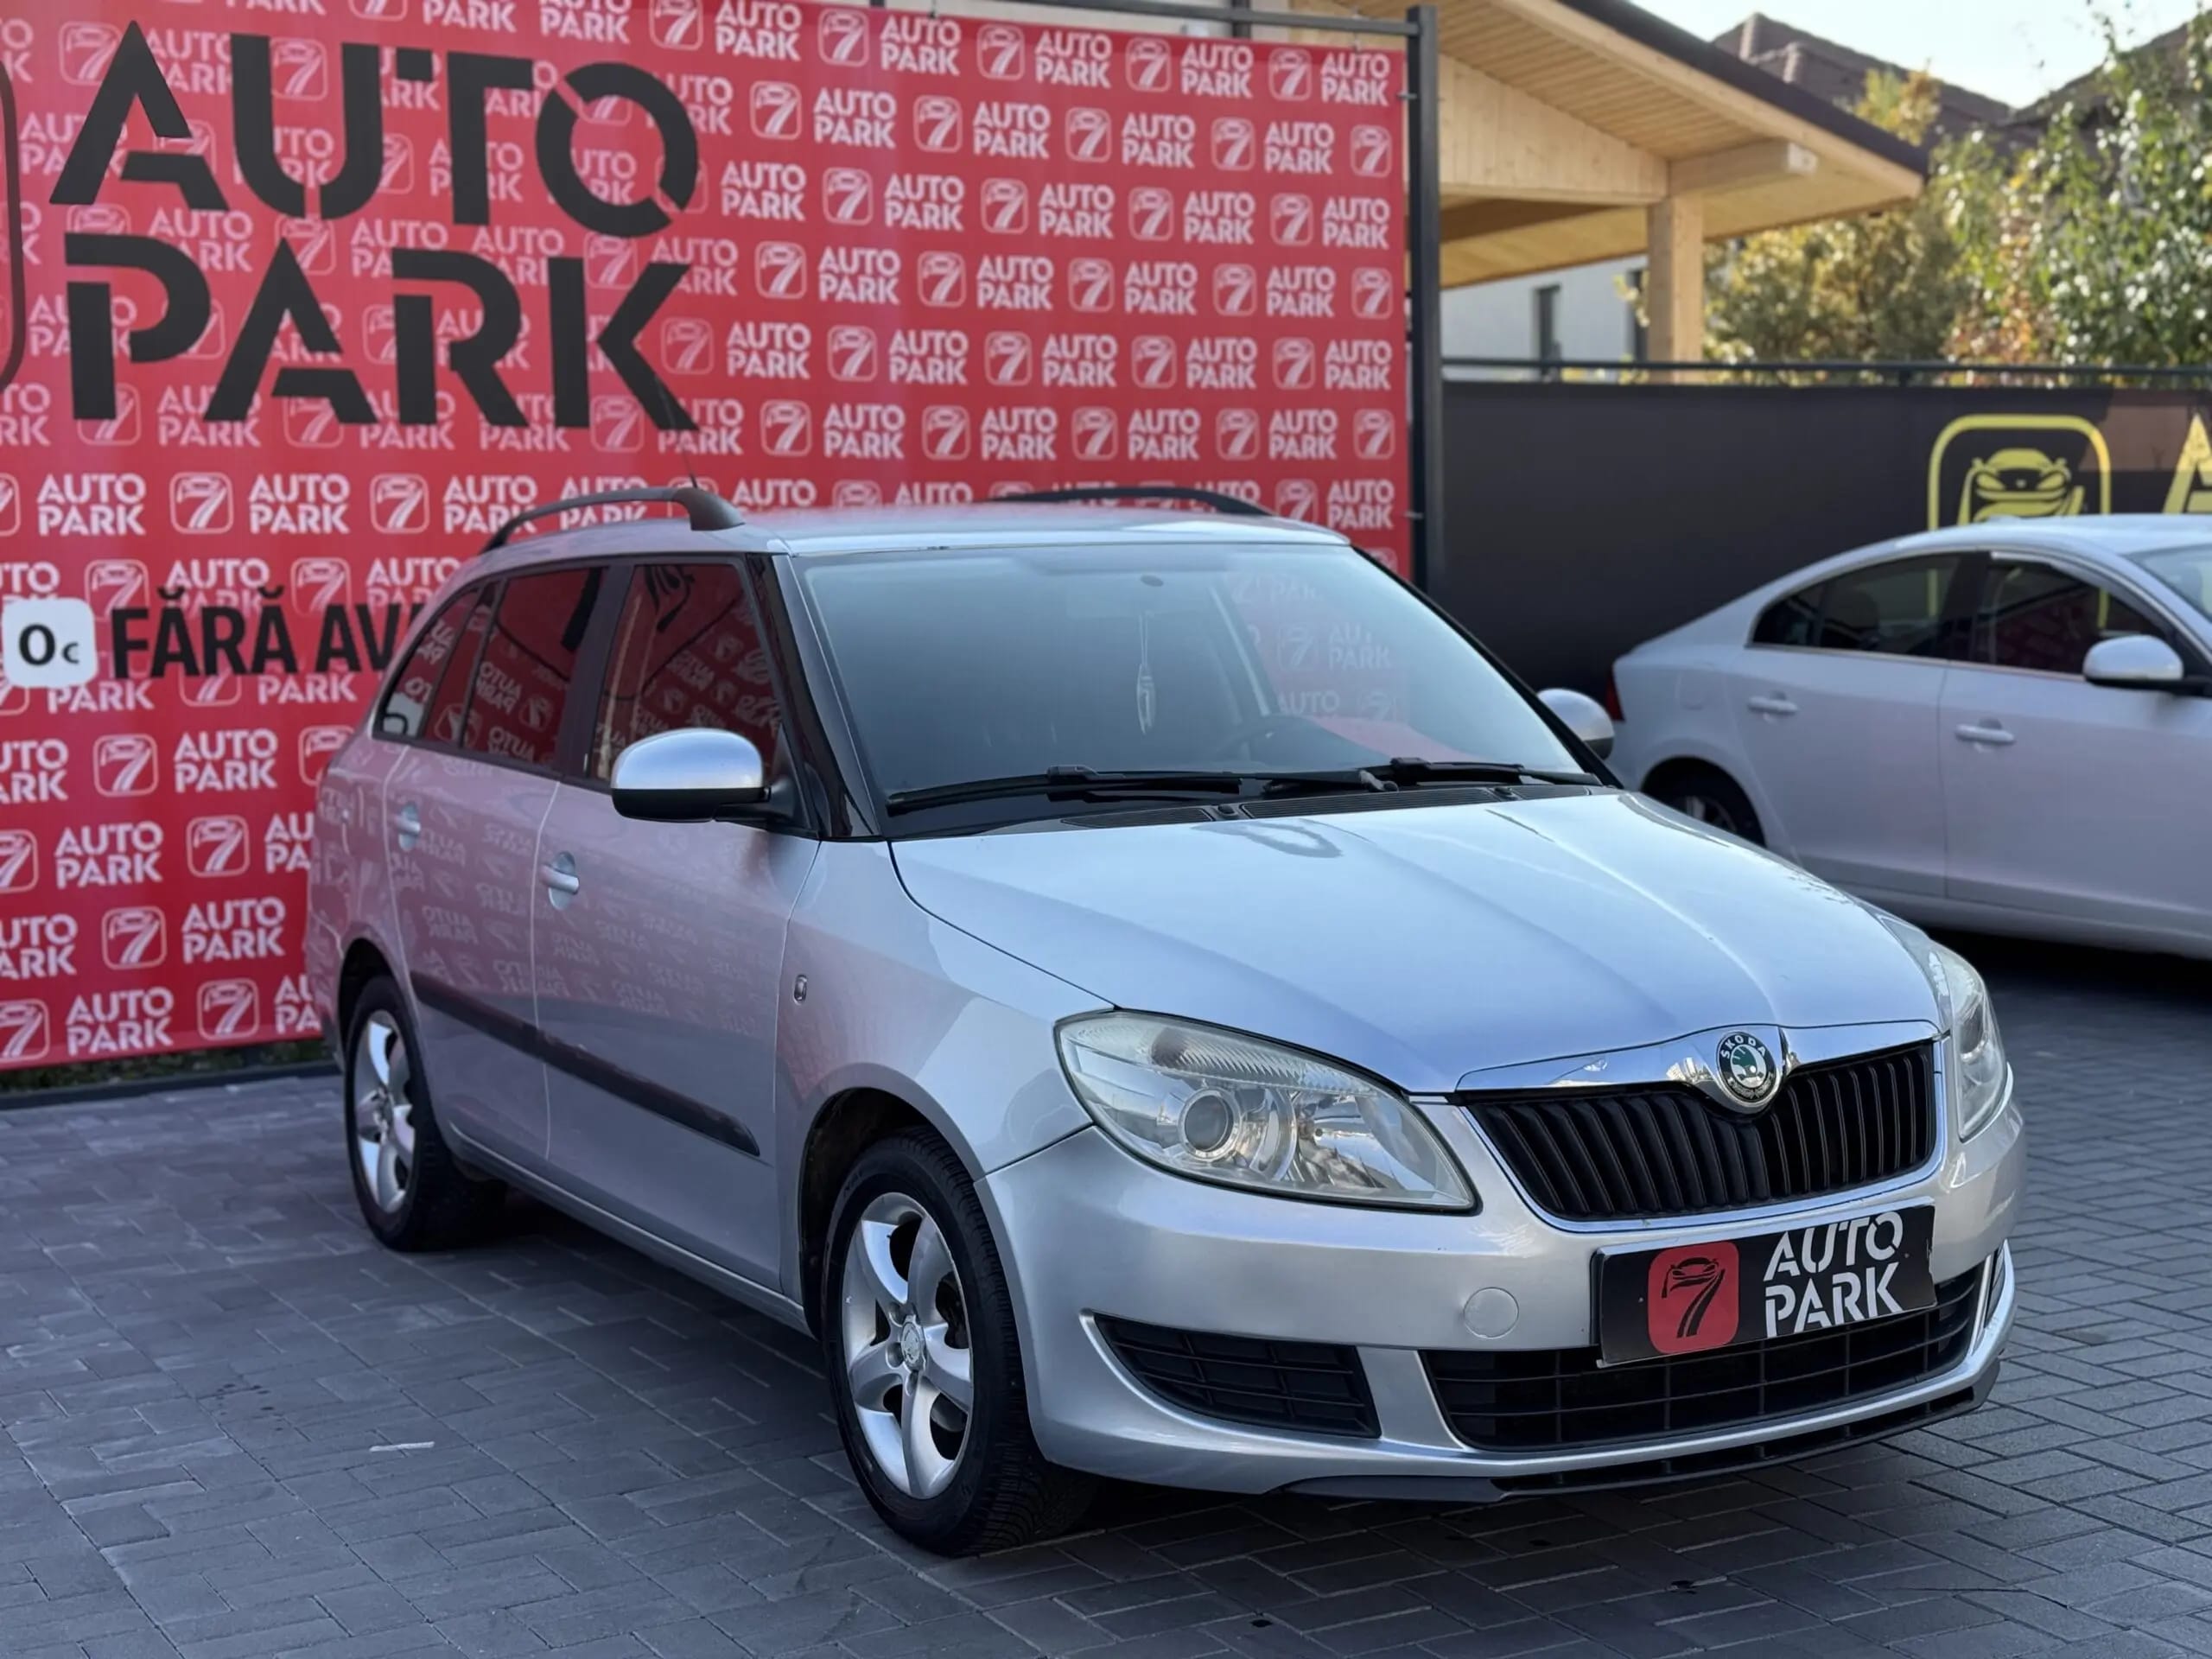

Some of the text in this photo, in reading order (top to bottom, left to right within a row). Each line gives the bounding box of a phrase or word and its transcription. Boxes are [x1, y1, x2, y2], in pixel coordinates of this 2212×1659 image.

[423, 1, 517, 33] PARK
[540, 12, 630, 43] PARK
[715, 0, 801, 31] AUTO
[716, 24, 799, 60] PARK
[880, 16, 962, 47] AUTO
[1035, 30, 1112, 60] AUTO
[881, 41, 960, 76] PARK
[1036, 54, 1111, 88] PARK
[1181, 44, 1253, 72] AUTO
[1321, 53, 1389, 79] AUTO
[1182, 67, 1251, 98] PARK
[1322, 76, 1387, 105] PARK
[814, 88, 896, 120] AUTO
[974, 103, 1050, 132] AUTO
[50, 20, 699, 238] AUTO
[815, 114, 894, 148] PARK
[974, 127, 1048, 158] PARK
[1122, 114, 1195, 142] AUTO
[1265, 123, 1334, 149] AUTO
[1122, 137, 1193, 168] PARK
[1265, 145, 1332, 174] PARK
[721, 162, 805, 192] AUTO
[885, 175, 963, 203] AUTO
[723, 188, 804, 220] PARK
[1039, 184, 1115, 212] AUTO
[1184, 192, 1255, 218] AUTO
[1323, 198, 1389, 223] AUTO
[149, 208, 253, 241] AUTO
[885, 199, 963, 230] PARK
[1039, 208, 1112, 238] PARK
[1185, 215, 1253, 244] PARK
[351, 219, 448, 250] AUTO
[472, 226, 564, 257] AUTO
[1323, 220, 1388, 249] PARK
[652, 238, 738, 267] AUTO
[819, 247, 900, 276] AUTO
[977, 257, 1053, 283] AUTO
[1125, 263, 1197, 289] AUTO
[1267, 267, 1335, 291] AUTO
[820, 273, 899, 304] PARK
[978, 281, 1052, 309] PARK
[1125, 286, 1195, 315] PARK
[1267, 290, 1333, 316] PARK
[64, 232, 702, 431] PARK
[728, 322, 810, 352] AUTO
[889, 330, 968, 358] AUTO
[1043, 334, 1117, 360] AUTO
[1186, 338, 1257, 363] AUTO
[1325, 340, 1391, 365] AUTO
[728, 349, 809, 378] PARK
[890, 355, 966, 384] PARK
[1043, 359, 1116, 386] PARK
[1187, 362, 1255, 388] PARK
[1325, 364, 1389, 389] PARK
[0, 416, 51, 447] RK
[158, 415, 262, 448] PARK
[824, 404, 905, 431] AUTO
[982, 408, 1057, 433] AUTO
[1128, 409, 1200, 434] AUTO
[1269, 410, 1338, 434] AUTO
[359, 420, 455, 450] PARK
[480, 423, 570, 452] PARK
[658, 428, 743, 455] PARK
[825, 429, 903, 458] PARK
[982, 433, 1055, 459] PARK
[1128, 434, 1198, 459] PARK
[1269, 433, 1336, 458] PARK
[37, 474, 145, 504] AUTO
[249, 474, 349, 503] AUTO
[443, 476, 538, 504] AUTO
[733, 478, 817, 507] AUTO
[894, 482, 972, 506] AUTO
[1327, 480, 1394, 505] AUTO
[39, 505, 144, 535] PARK
[251, 503, 348, 533] PARK
[1327, 503, 1392, 530] PARK
[165, 558, 270, 589] AUTO
[111, 585, 298, 679] FĂRĂ
[315, 602, 425, 673] AV
[48, 678, 155, 715] PARK
[258, 673, 357, 705] PARK
[175, 729, 277, 763] AUTO
[175, 758, 276, 792] PARK
[55, 822, 162, 857] AUTO
[264, 812, 314, 842] AU
[57, 852, 161, 888] PARK
[265, 843, 312, 874] PA
[182, 897, 285, 933] AUTO
[0, 914, 77, 949] UTO
[183, 926, 283, 963] PARK
[0, 944, 75, 979] ARK
[67, 988, 173, 1026] AUTO
[274, 1003, 322, 1034] PA
[67, 1017, 173, 1056] PARK
[1764, 1211, 1904, 1282] AUTO
[1765, 1262, 1904, 1338] PARK
